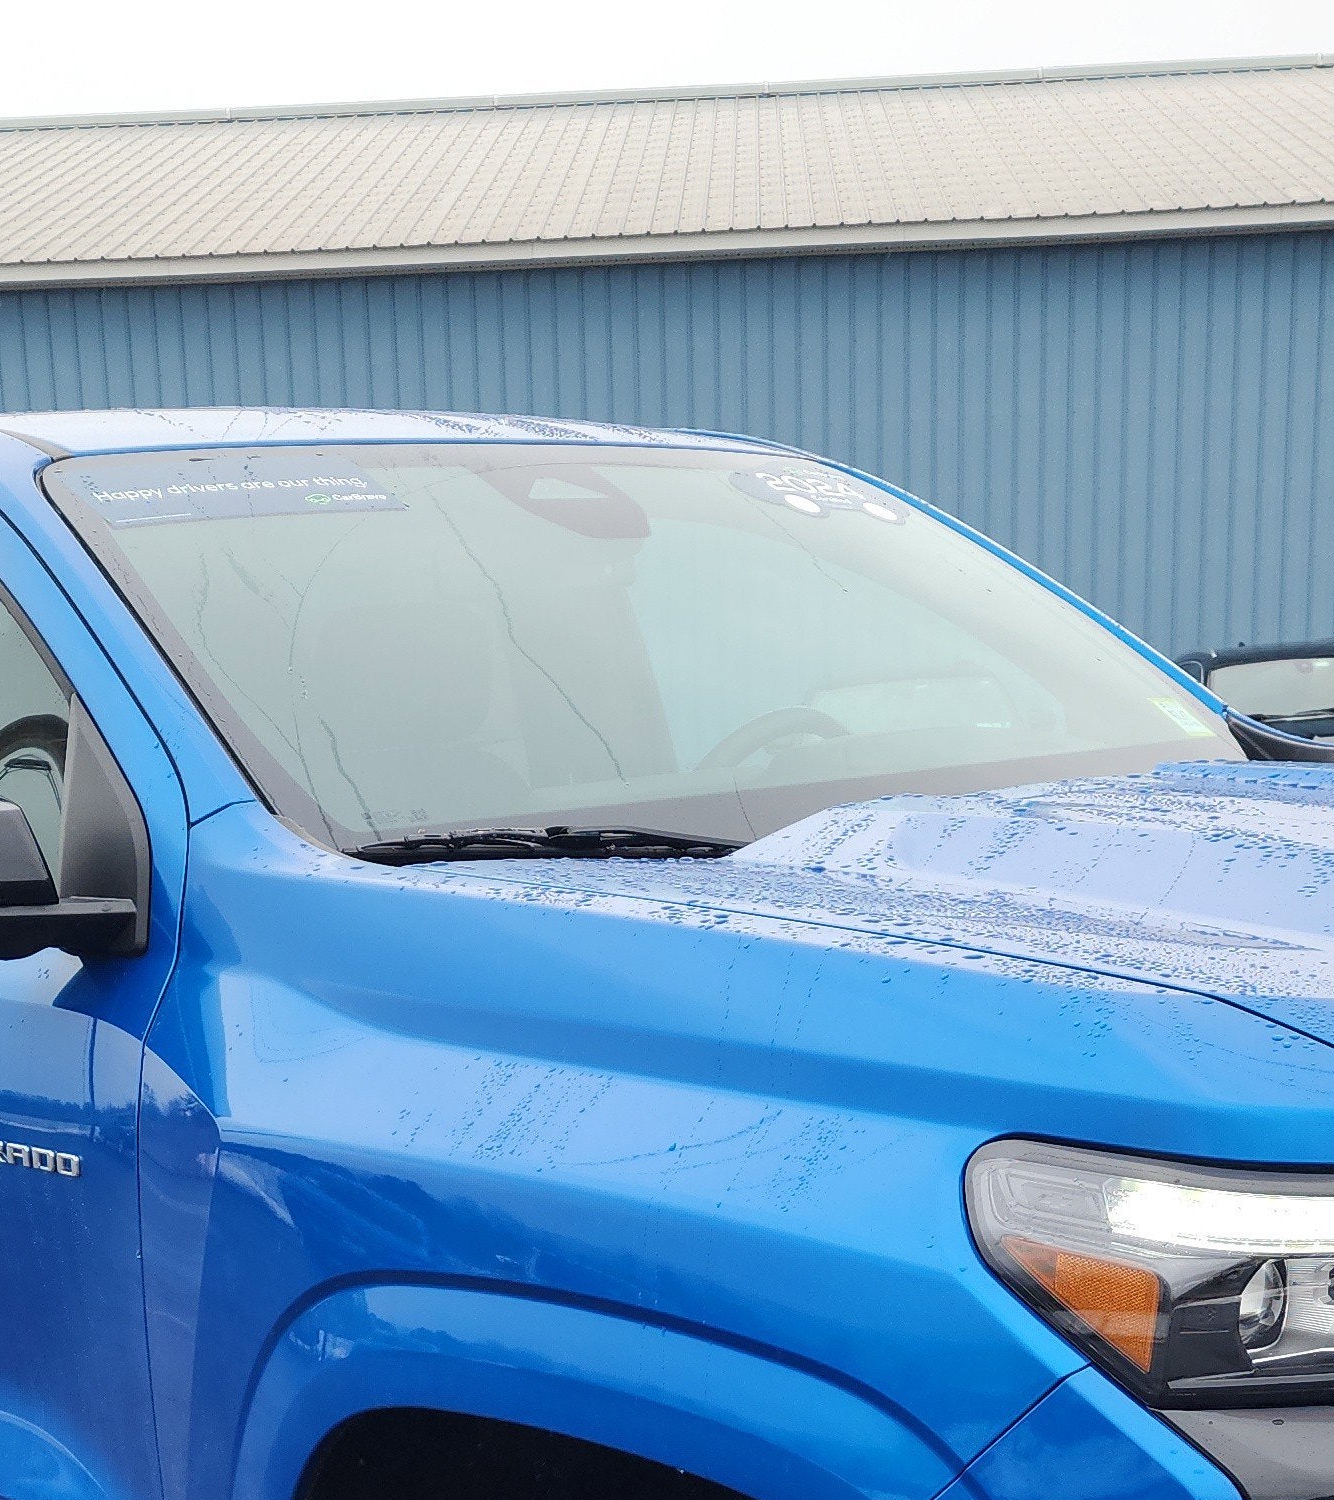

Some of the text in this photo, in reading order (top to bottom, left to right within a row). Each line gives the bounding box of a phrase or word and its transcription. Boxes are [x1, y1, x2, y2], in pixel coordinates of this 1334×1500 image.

[91, 487, 163, 501] Happy
[167, 482, 238, 494] drivers
[241, 480, 275, 490] are
[277, 478, 310, 489] our
[755, 472, 867, 501] 2024
